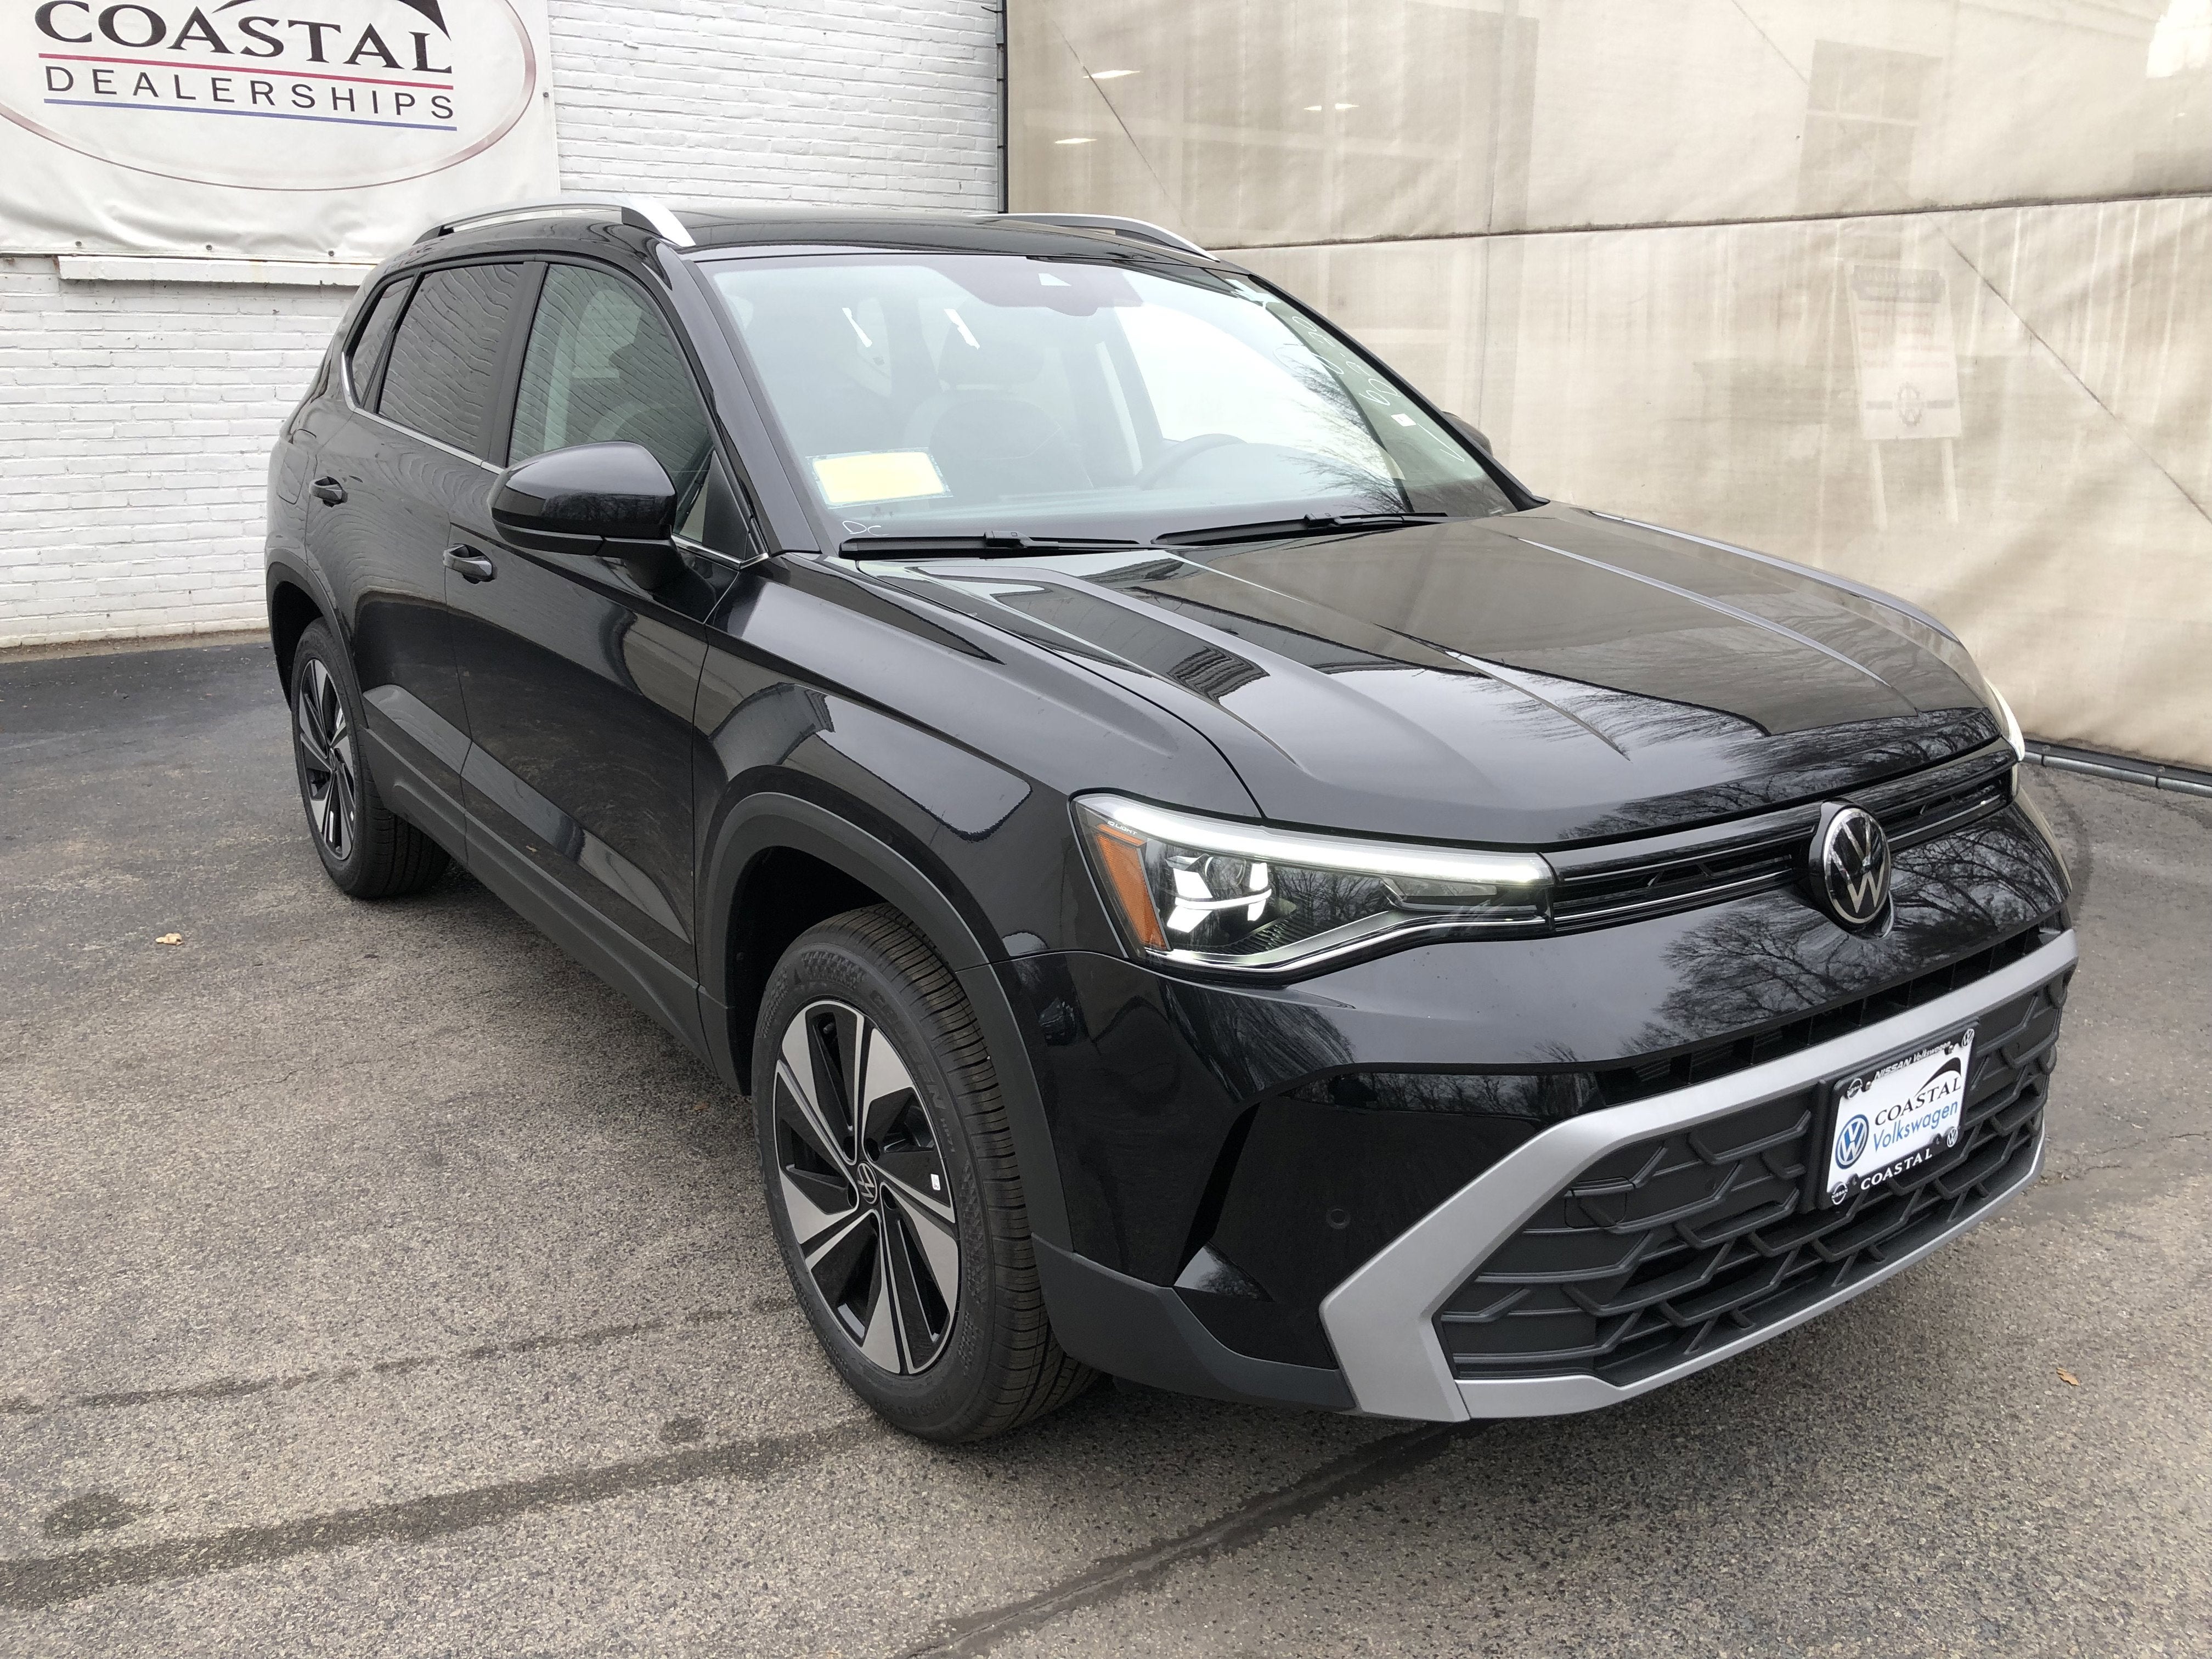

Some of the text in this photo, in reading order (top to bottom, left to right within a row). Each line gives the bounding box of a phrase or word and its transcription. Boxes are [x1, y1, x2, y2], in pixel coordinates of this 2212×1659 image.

[35, 0, 452, 74] COASTAL
[47, 66, 454, 120] DEALERSHIPS
[1873, 1057, 1912, 1080] NISSAN
[1875, 1076, 1962, 1126] COASTAL
[1873, 1101, 1959, 1153] Volkswagen
[1860, 1148, 1933, 1191] COASTAL
